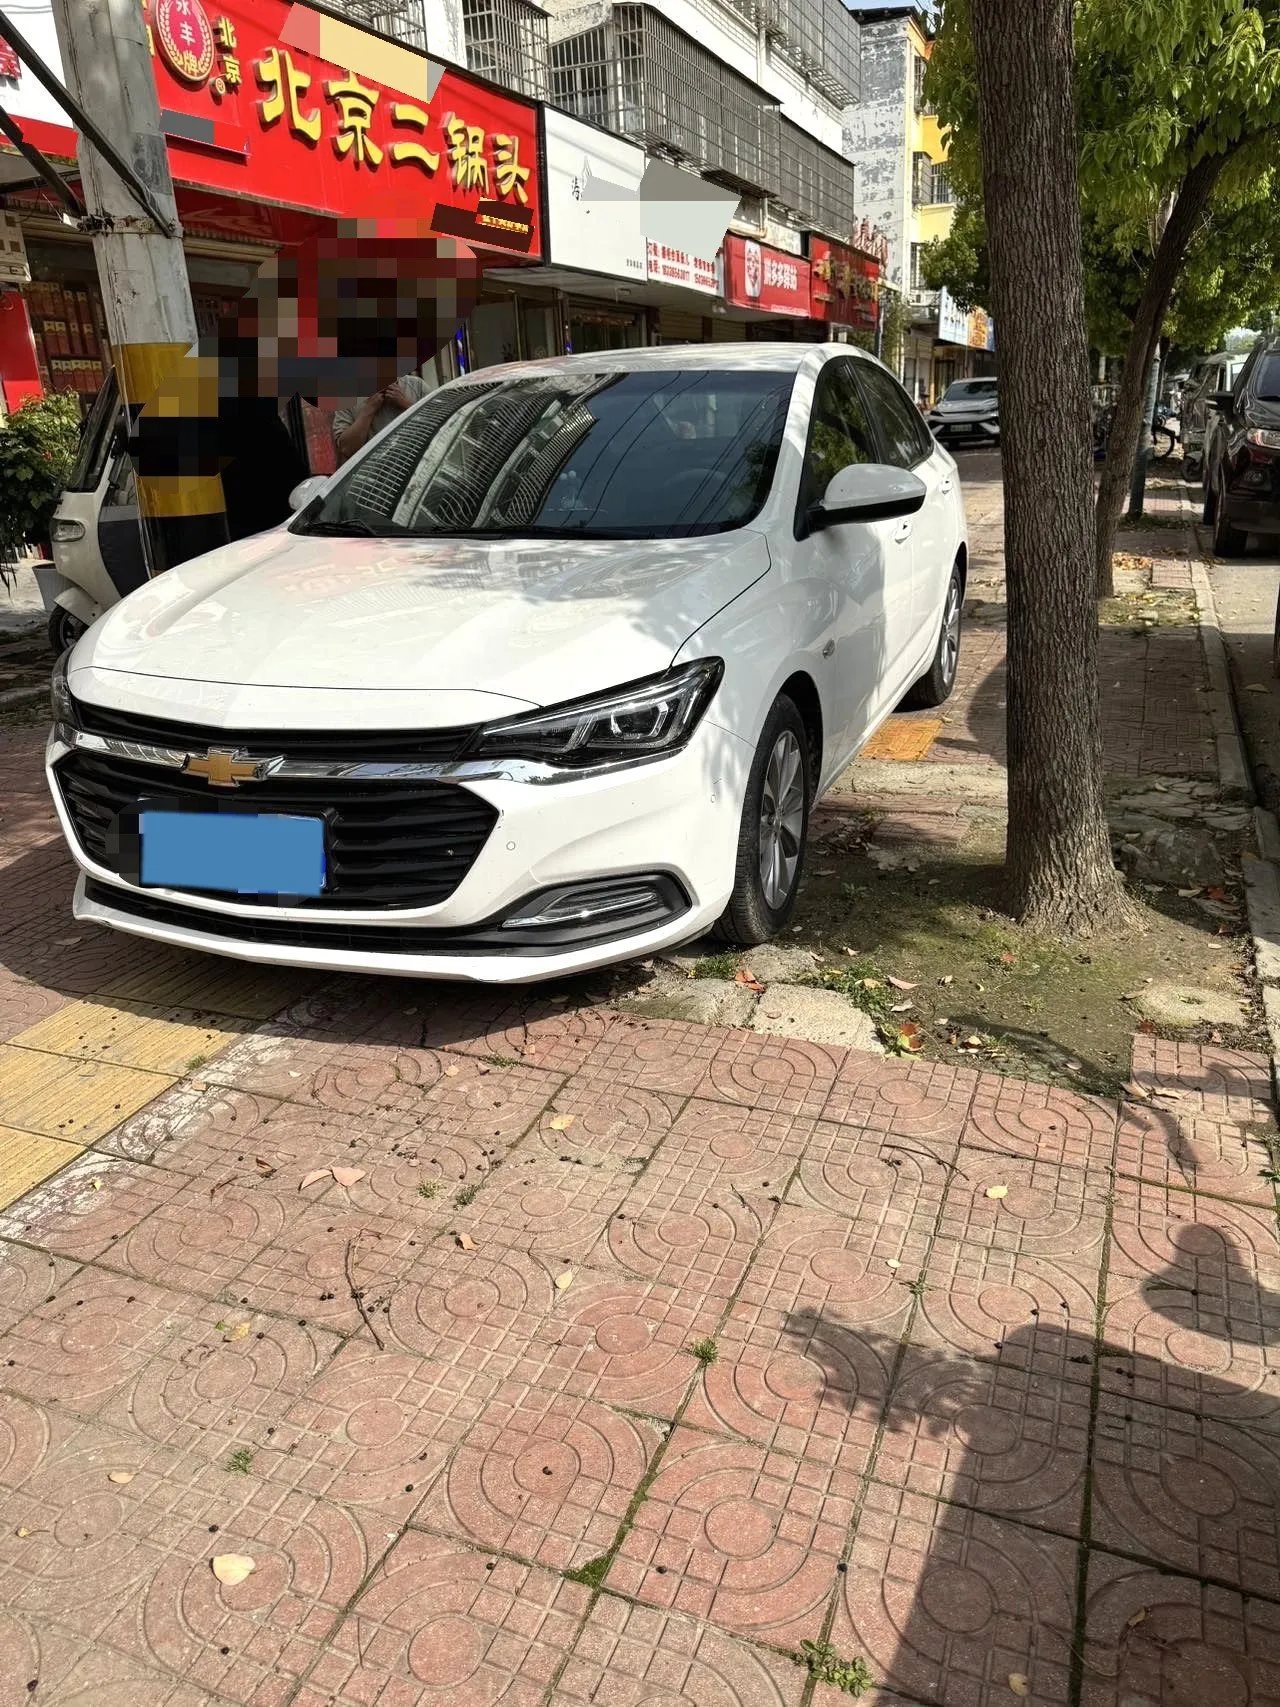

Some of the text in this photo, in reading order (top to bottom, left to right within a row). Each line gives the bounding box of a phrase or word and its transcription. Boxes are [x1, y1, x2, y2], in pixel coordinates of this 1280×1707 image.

[218, 15, 242, 84] 北京
[255, 47, 530, 204] 北京二锅头
